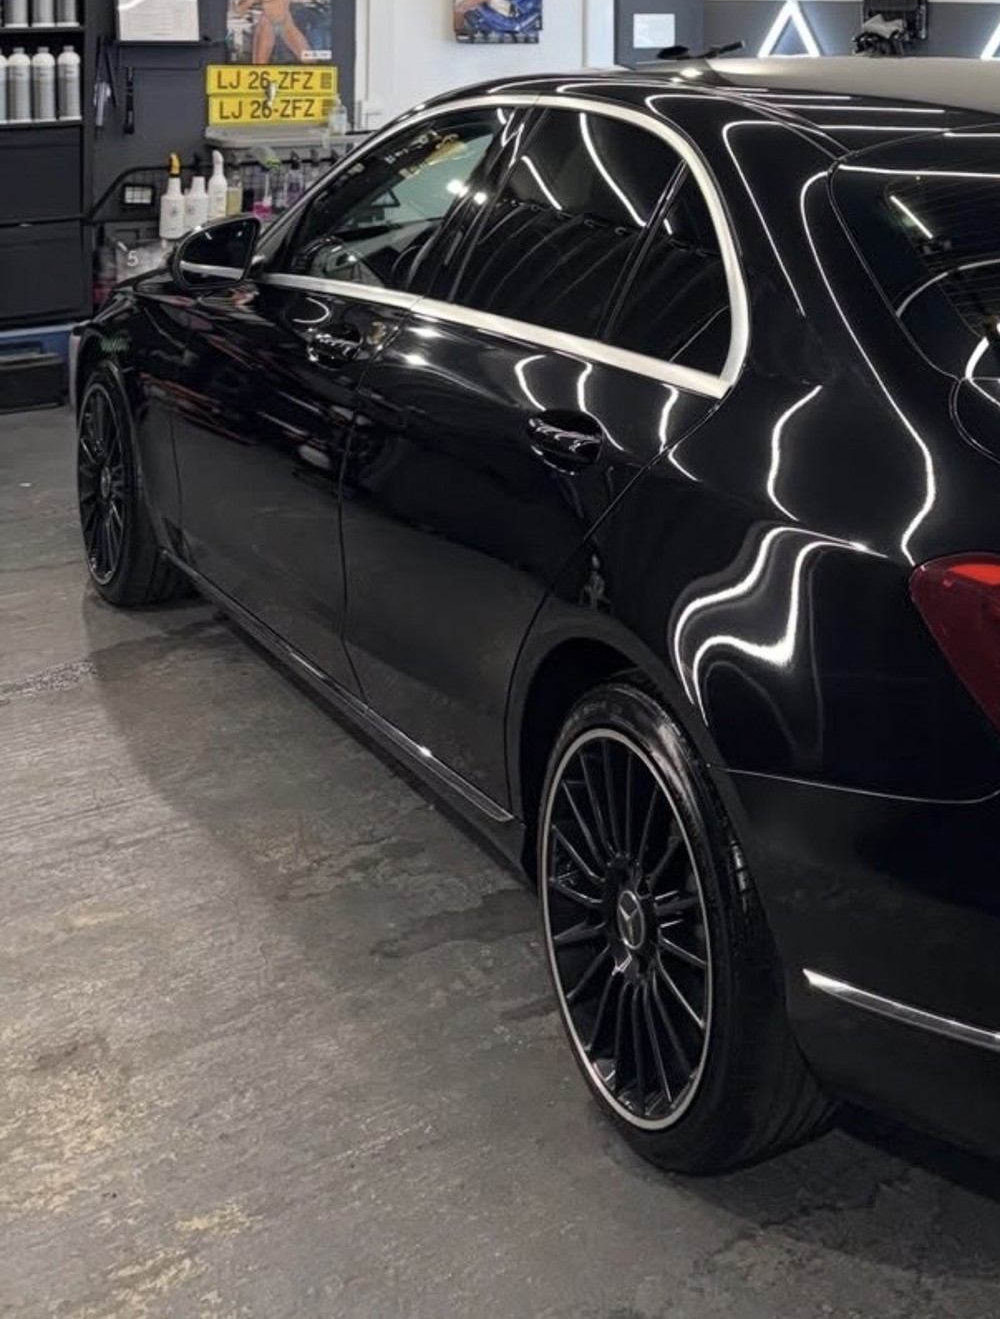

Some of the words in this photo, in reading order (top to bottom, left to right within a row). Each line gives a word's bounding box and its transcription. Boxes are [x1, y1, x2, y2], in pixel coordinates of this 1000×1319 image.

[217, 71, 240, 89] LJ
[248, 70, 314, 90] 26-ZFZ
[219, 100, 243, 119] LJ
[250, 99, 315, 119] 26-ZFZ
[126, 250, 138, 267] 5
